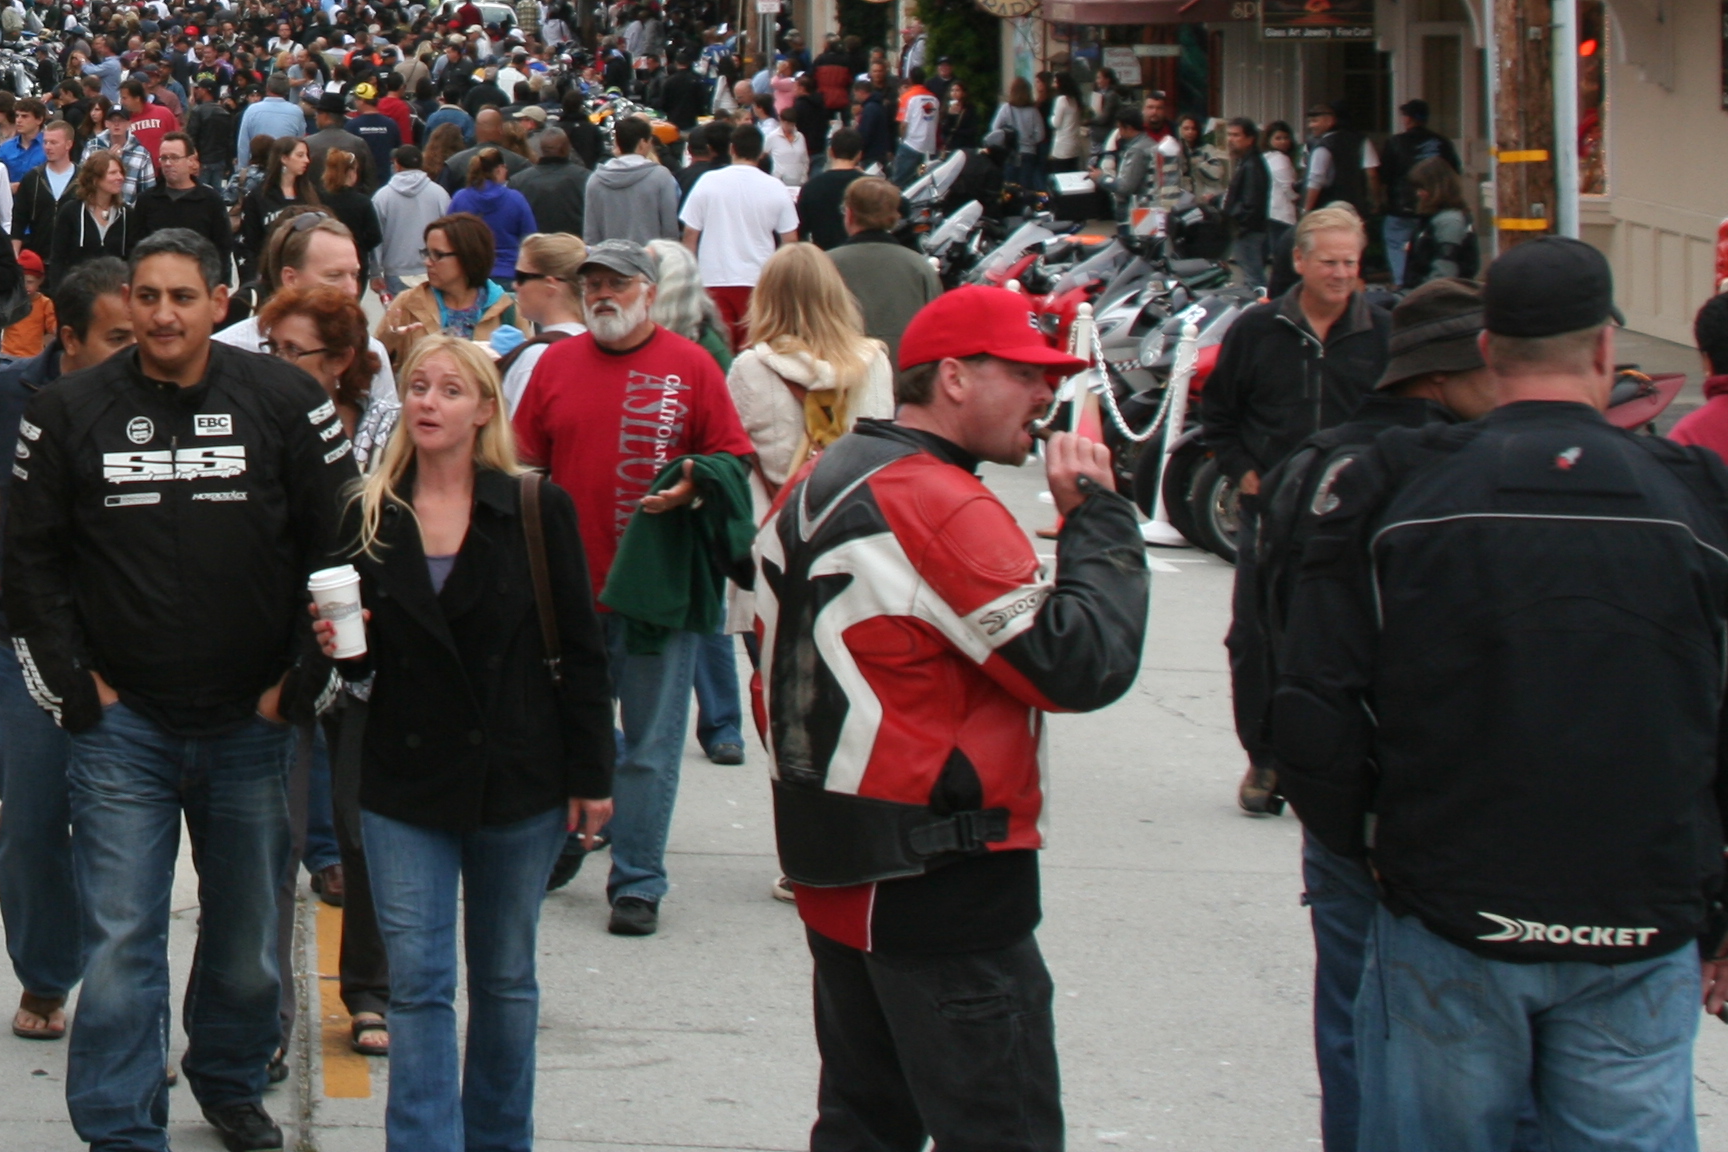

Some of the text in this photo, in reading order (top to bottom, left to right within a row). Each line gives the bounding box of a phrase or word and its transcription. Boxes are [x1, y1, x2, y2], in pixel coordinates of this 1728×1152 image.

[131, 119, 161, 132] NTEREY
[197, 417, 229, 428] EBC
[653, 373, 682, 475] CALIFORNI
[1518, 918, 1659, 947] ROCKET
